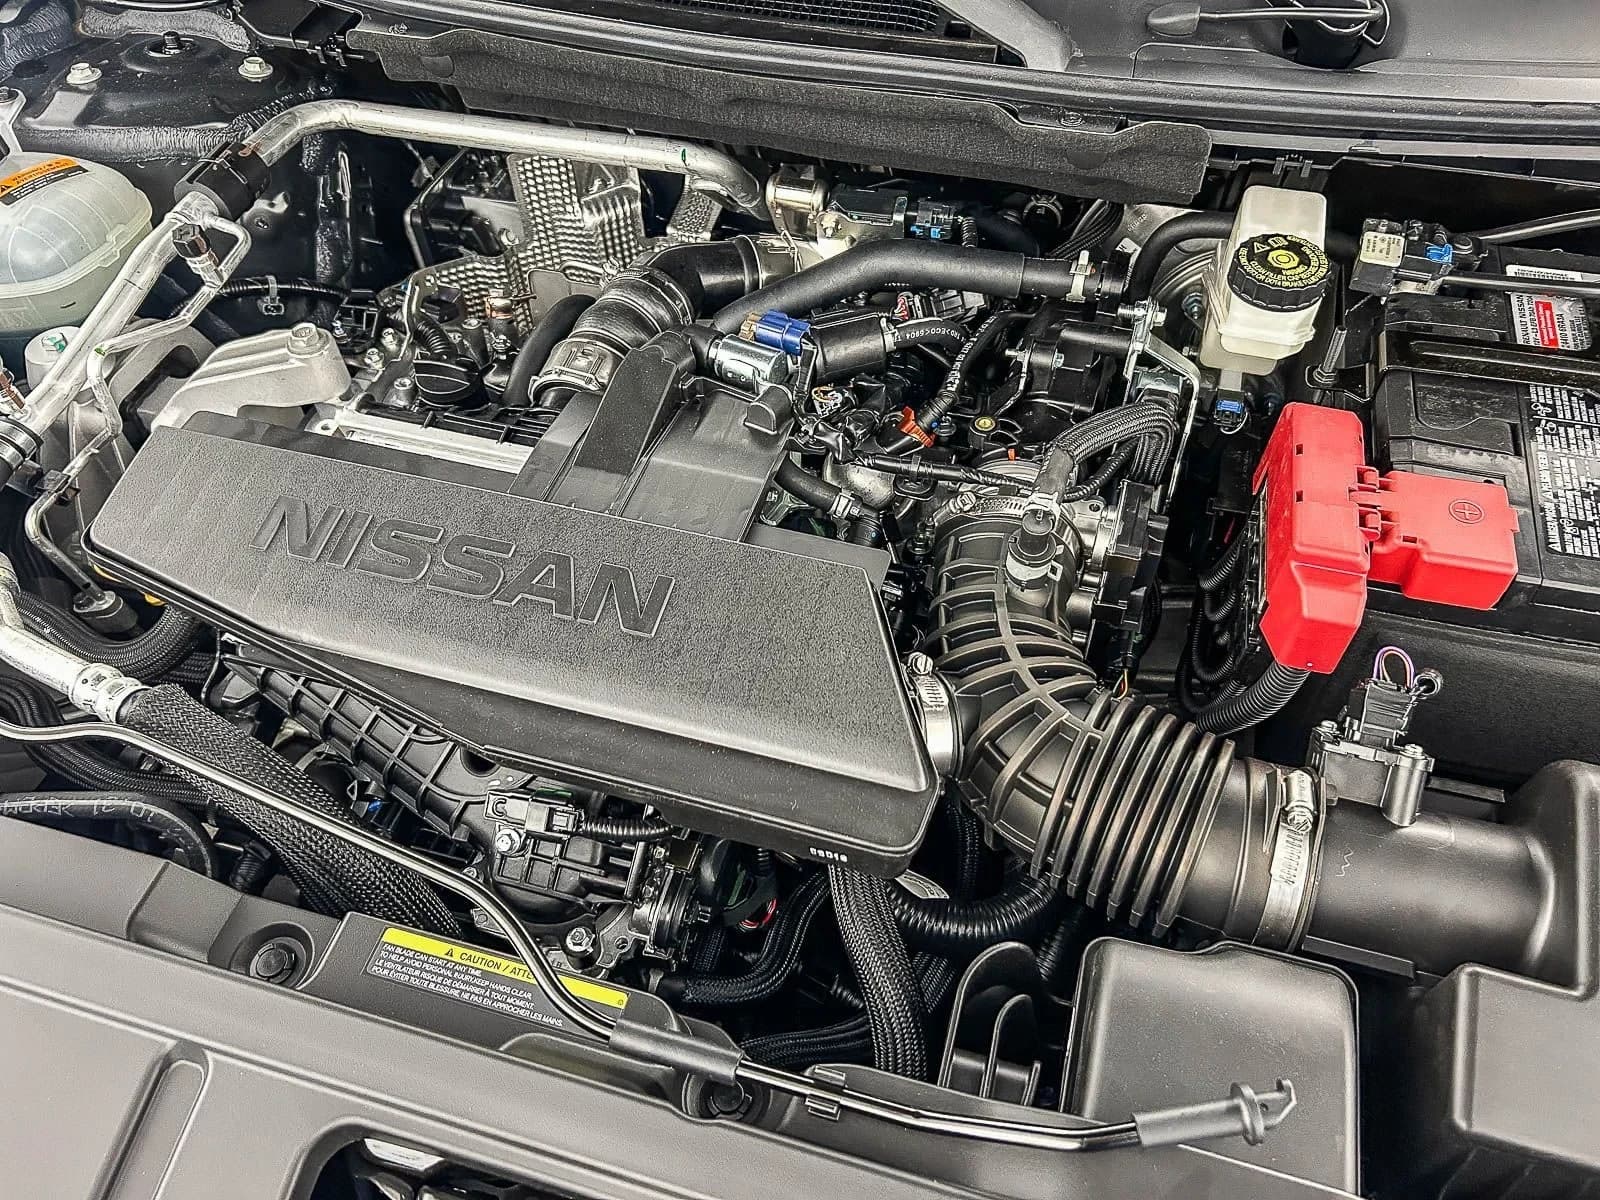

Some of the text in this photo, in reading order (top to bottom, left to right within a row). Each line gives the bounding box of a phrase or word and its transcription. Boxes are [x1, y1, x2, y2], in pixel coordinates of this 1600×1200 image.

[1516, 295, 1526, 319] NISSAN
[248, 494, 675, 638] NISSAN
[380, 951, 389, 959] TO
[389, 953, 404, 963] HELP
[404, 957, 423, 968] AVOID
[422, 963, 453, 977] PERSONAL
[490, 982, 511, 992] HANDS
[382, 944, 395, 953] FAN
[393, 946, 413, 958] BLADE
[414, 952, 428, 962] CAN
[428, 955, 448, 967] START
[454, 964, 467, 973] ANY
[459, 952, 502, 970] CAUTION
[371, 966, 389, 976] POUR
[388, 969, 410, 982] ÉVITER
[409, 976, 429, 988] TOUTE
[460, 992, 470, 1000] NE
[469, 994, 482, 1003] PAS
[482, 998, 492, 1006] EN
[491, 1000, 530, 1017] APPROCHER
[530, 1011, 543, 1020] LES
[383, 961, 421, 976] VENTILATEUR
[420, 971, 444, 984] RISQUE
[443, 977, 453, 986] DE
[452, 979, 485, 996] DÉMARRER
[491, 992, 507, 1002] TOUT
